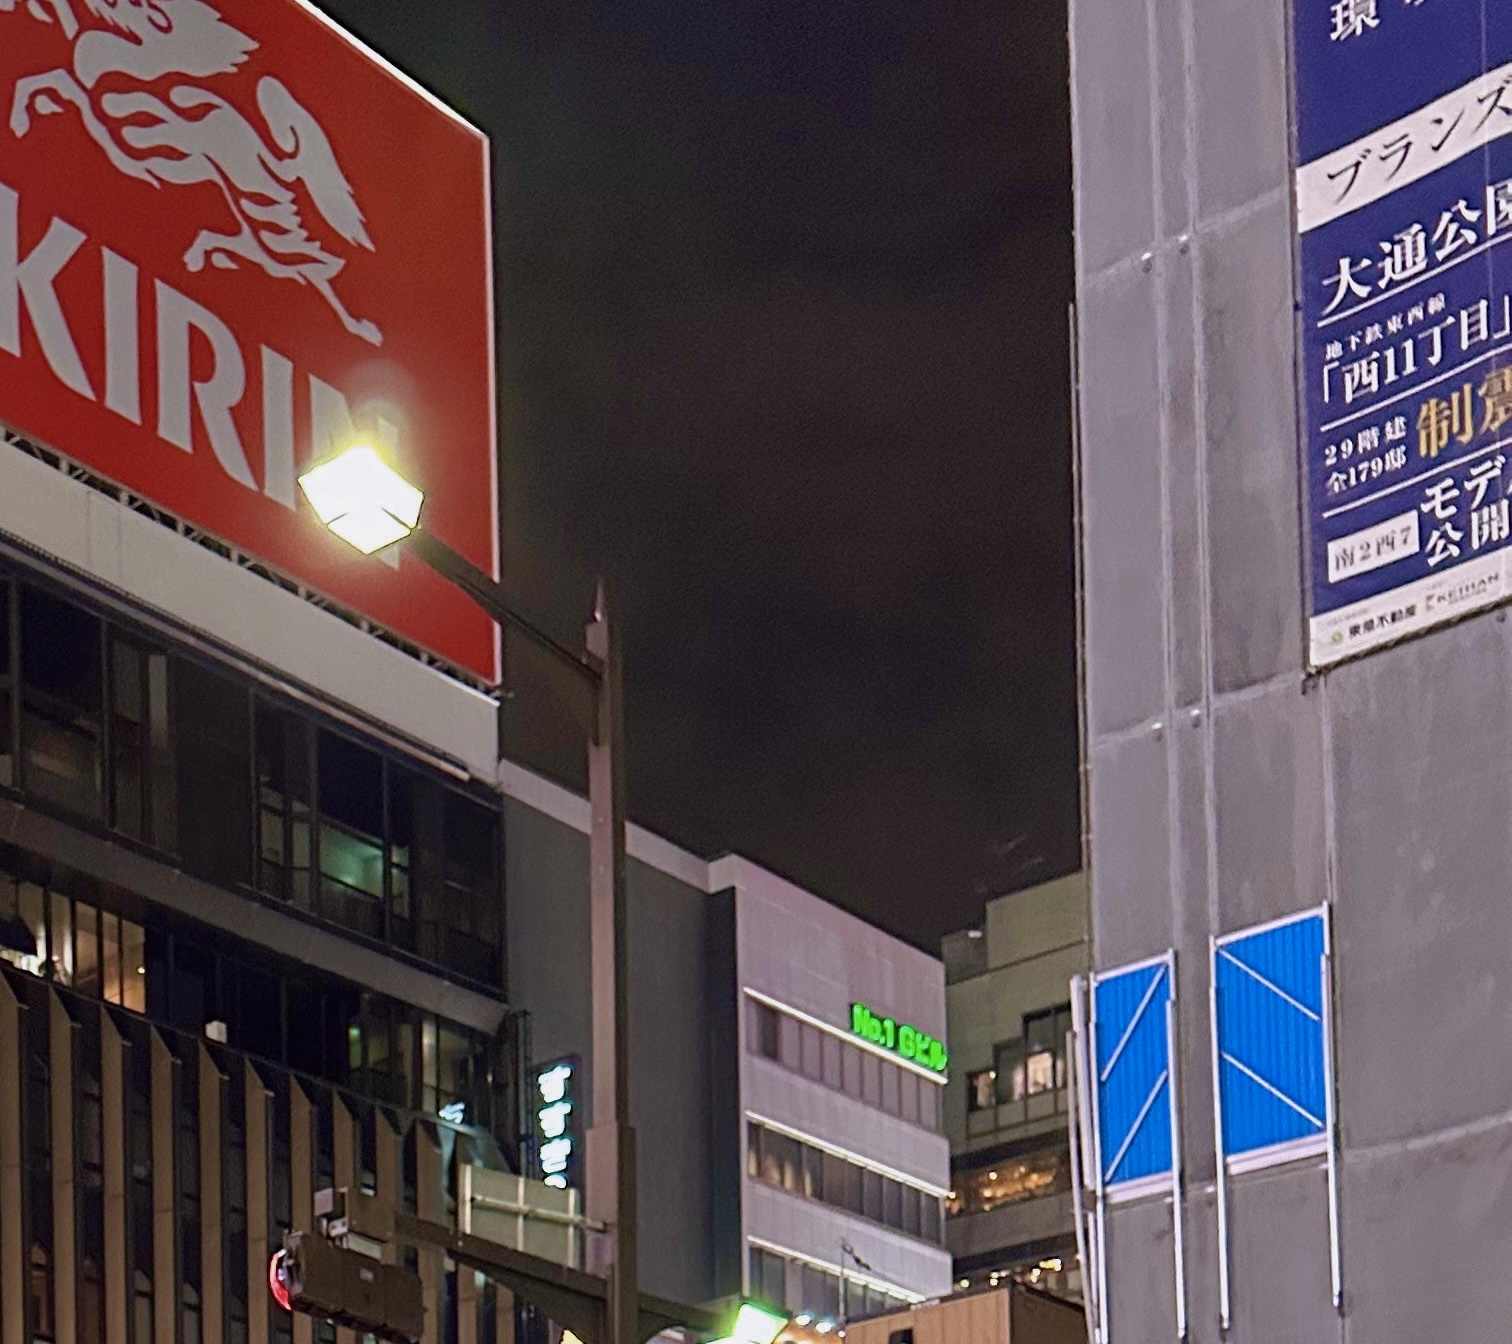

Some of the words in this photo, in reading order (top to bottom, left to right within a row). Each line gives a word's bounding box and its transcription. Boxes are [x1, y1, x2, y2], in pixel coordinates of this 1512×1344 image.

[1323, 294, 1511, 403] 「西11丁目」
[1420, 454, 1512, 521] モデ
[1335, 525, 1413, 572] 南2西7
[852, 1003, 895, 1049] No.1
